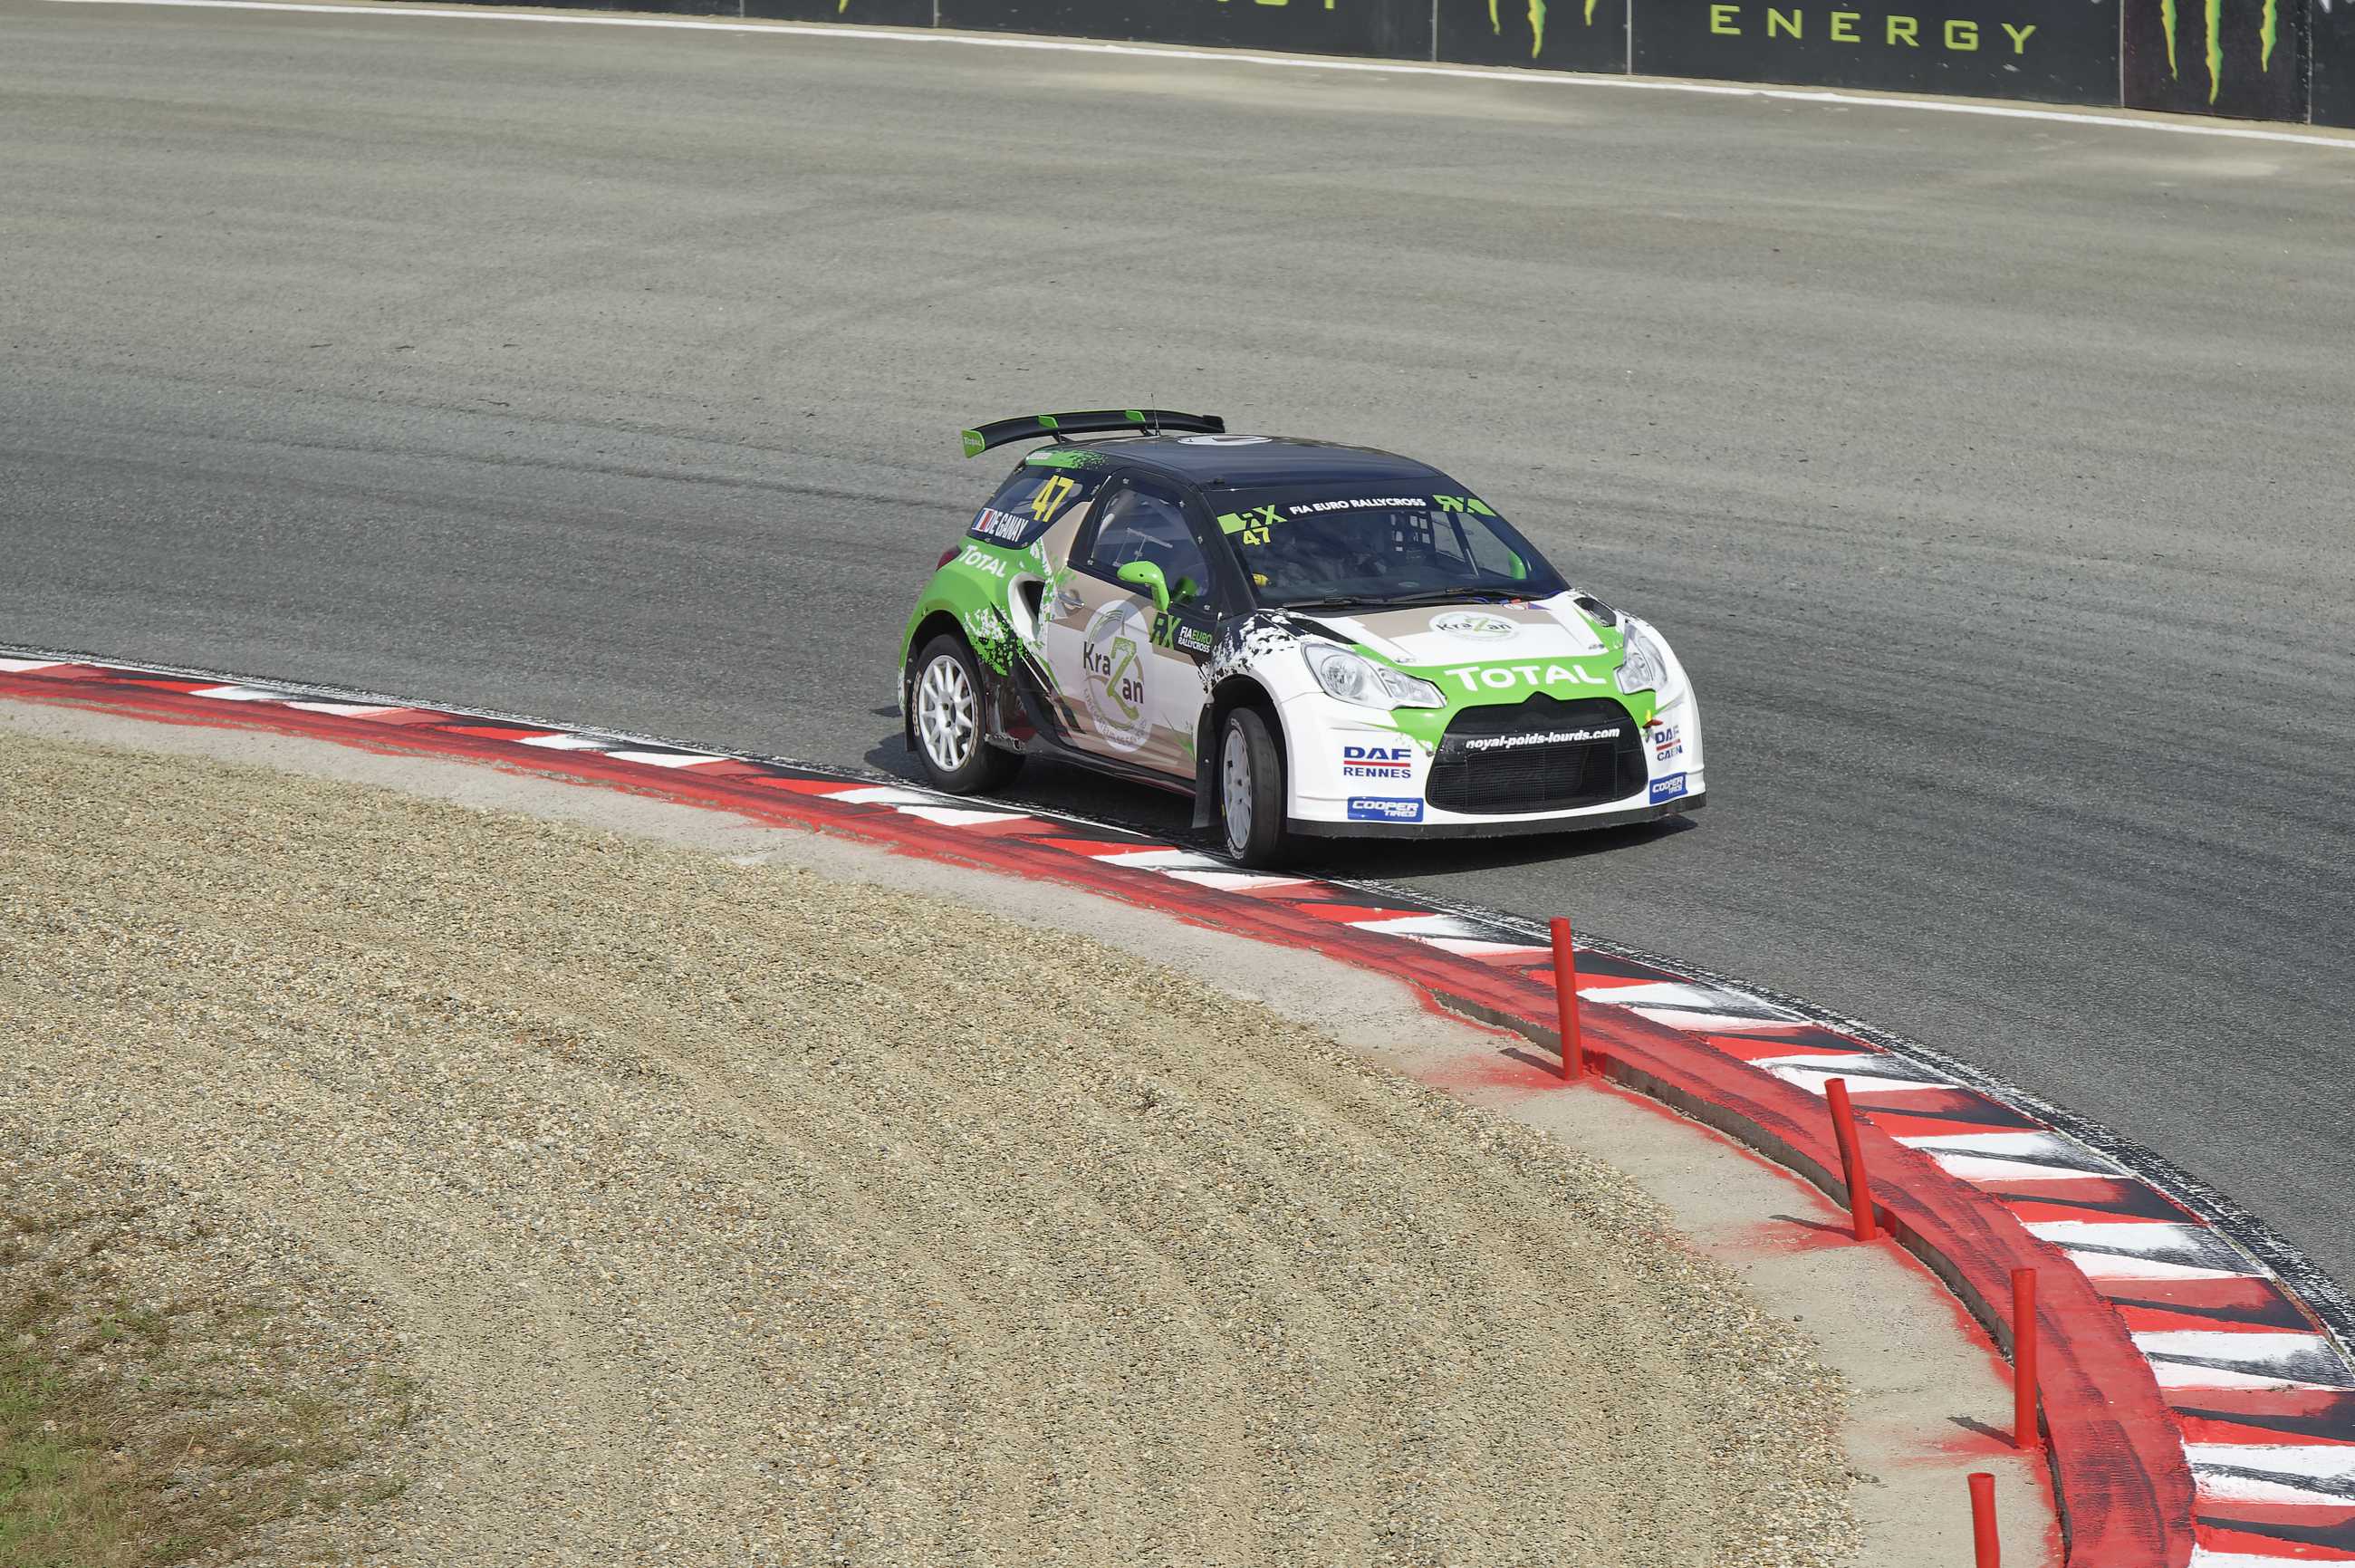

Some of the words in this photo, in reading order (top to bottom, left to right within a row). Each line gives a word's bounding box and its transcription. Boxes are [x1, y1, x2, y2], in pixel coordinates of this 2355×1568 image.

[1710, 5, 2036, 54] ENERGY
[1031, 475, 1074, 523] 47
[1289, 505, 1312, 515] FIA
[1312, 501, 1349, 513] EURO
[1351, 498, 1427, 508] RALLYCROSS
[984, 510, 1004, 534] DE
[995, 513, 1029, 543] GANAY
[1243, 526, 1271, 545] 47
[959, 544, 1008, 578] TOTAL
[1444, 665, 1607, 691] TOTAL
[1655, 725, 1680, 744] DAF
[1343, 746, 1412, 760] DAF
[1343, 766, 1412, 778] RENNES
[1351, 800, 1419, 812] COOPER
[1383, 809, 1417, 817] TIRES
